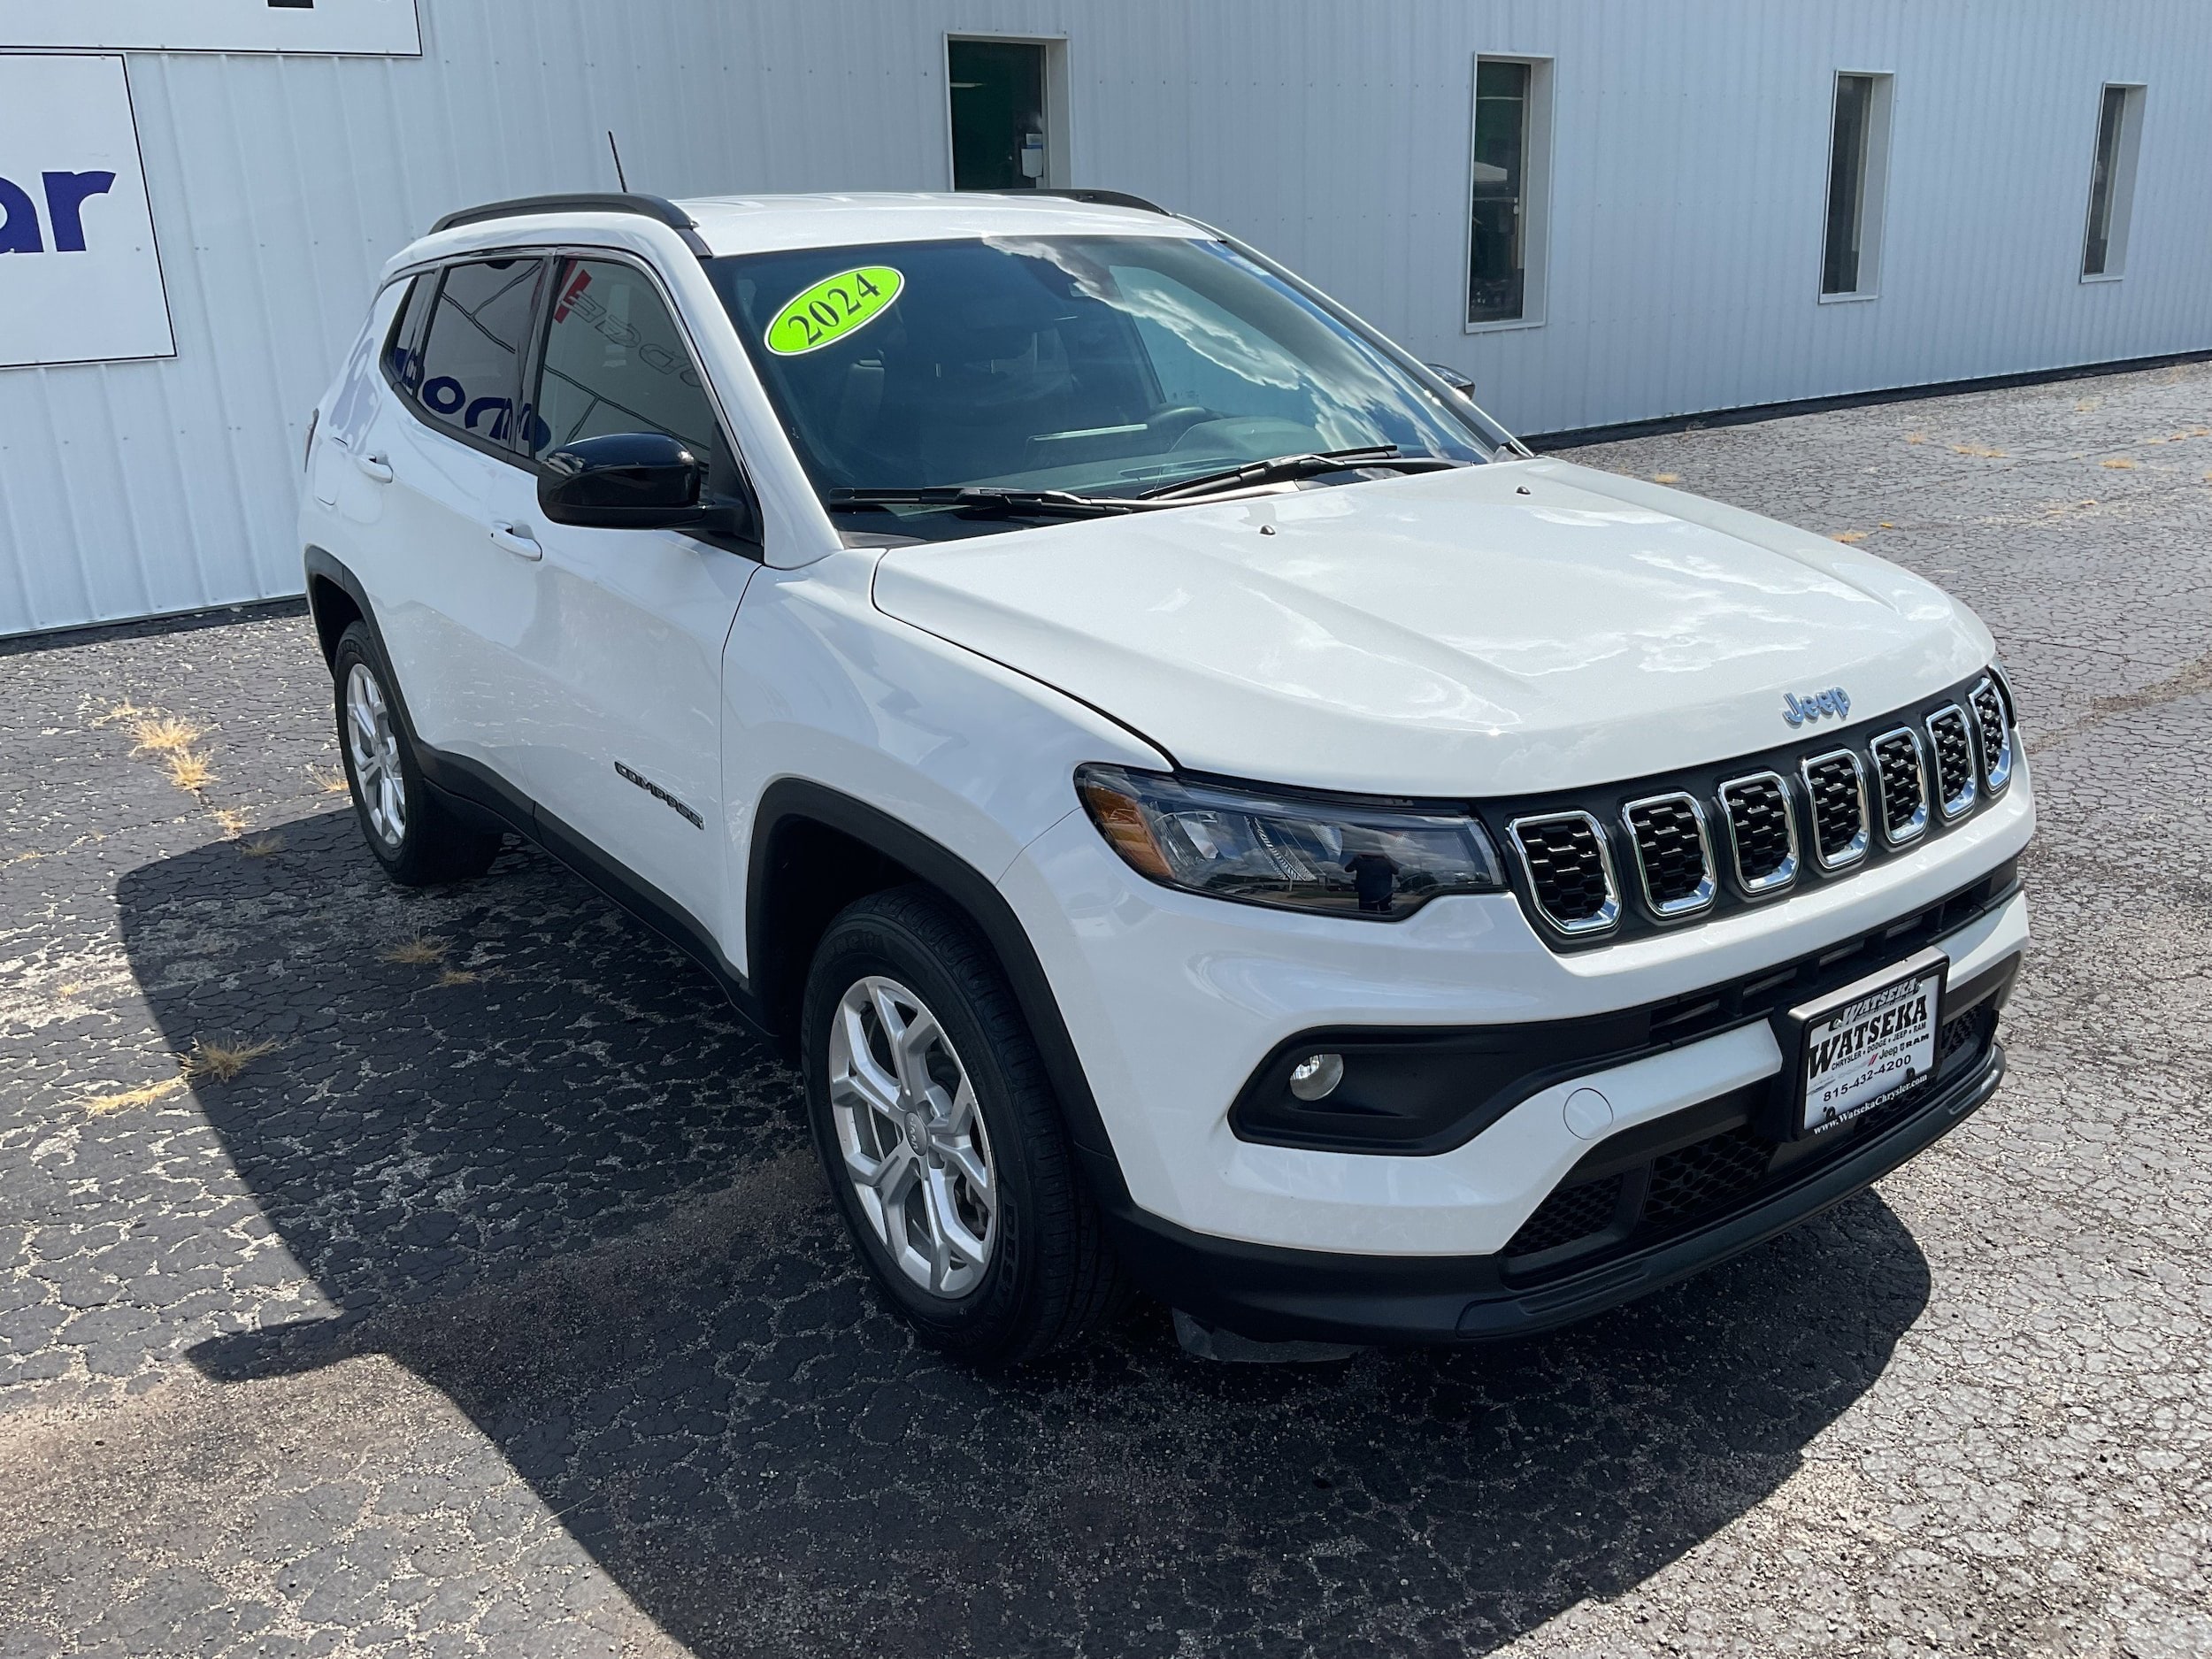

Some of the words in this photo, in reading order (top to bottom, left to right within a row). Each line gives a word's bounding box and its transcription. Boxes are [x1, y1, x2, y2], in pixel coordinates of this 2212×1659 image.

[787, 273, 880, 346] 2024
[1782, 687, 1851, 725] Jeep
[614, 761, 704, 830] COMPASS
[1842, 978, 1916, 1026] WATSEKA
[1809, 995, 1927, 1079] WATSEKA
[1832, 1050, 1862, 1071] CHRYSLER
[1867, 1038, 1887, 1055] DODGE
[1893, 1029, 1908, 1042] JEEP
[1913, 1021, 1926, 1034] RAM
[1878, 1047, 1898, 1061] Jeep
[1906, 1033, 1930, 1048] RAM
[1823, 1054, 1911, 1102] 815-432-4200
[1814, 1074, 1928, 1135] www.WatsekaChrysler.com
